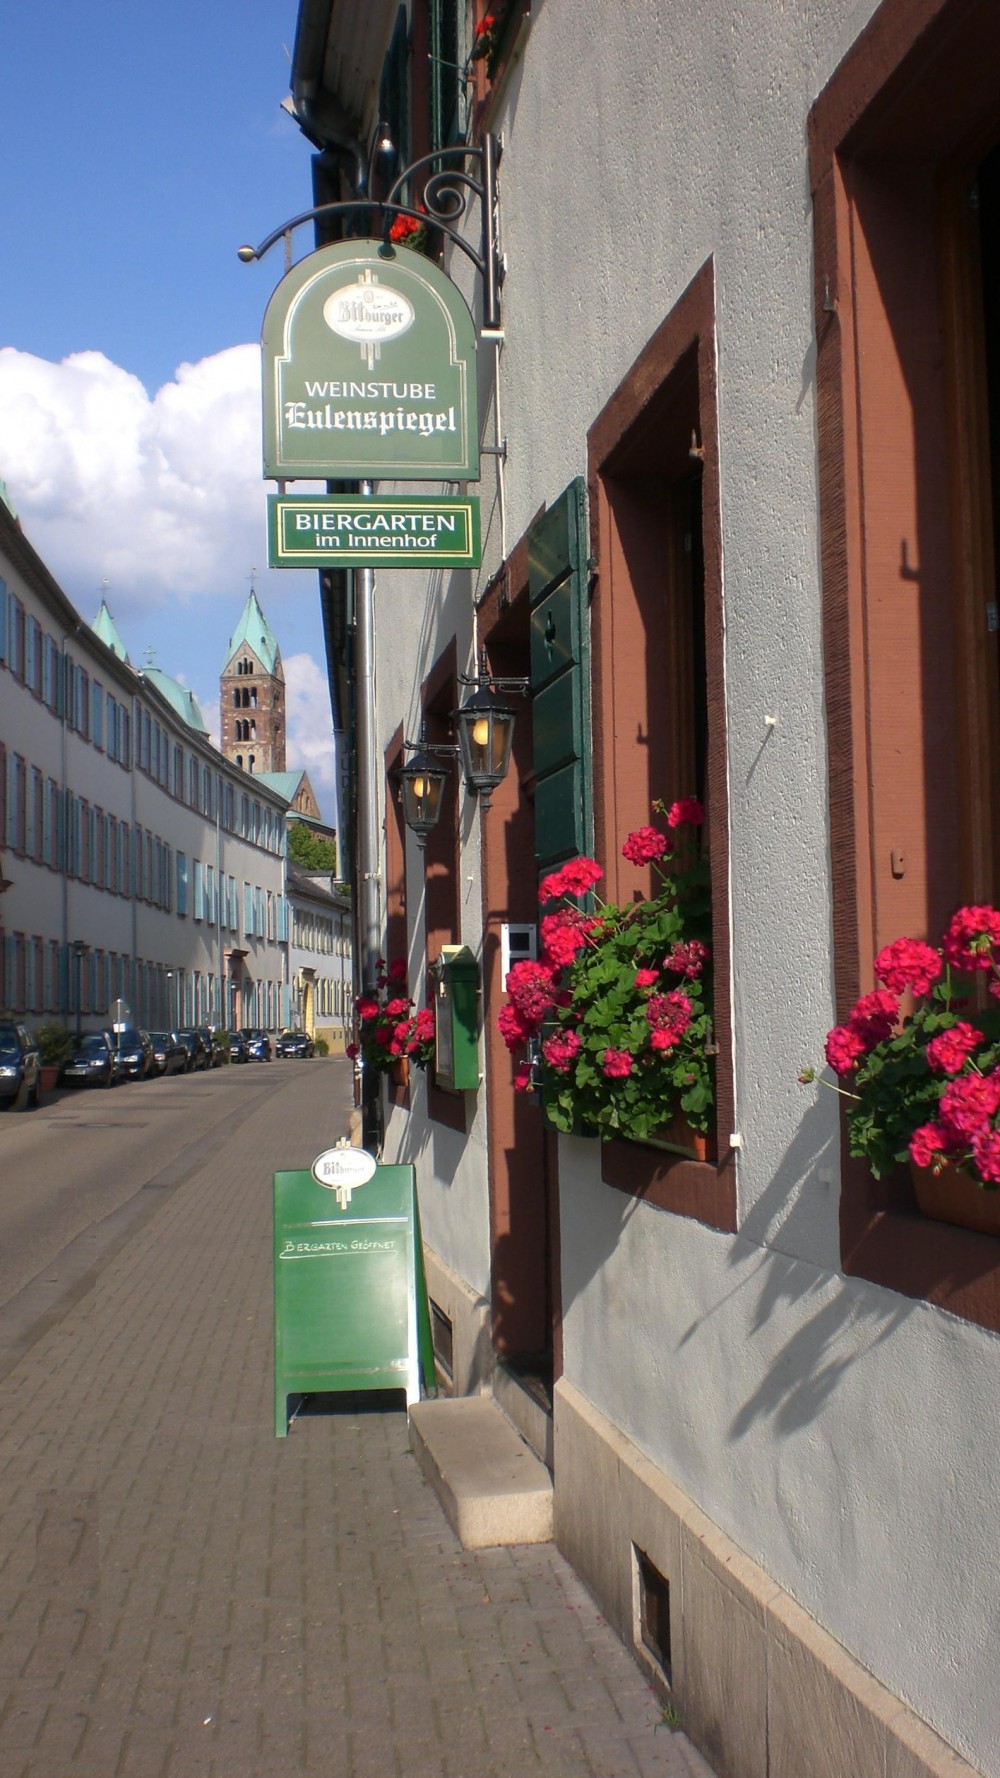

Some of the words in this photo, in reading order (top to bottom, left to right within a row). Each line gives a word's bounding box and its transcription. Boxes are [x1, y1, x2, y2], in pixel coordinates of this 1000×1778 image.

[337, 300, 404, 326] Bitburger
[304, 381, 436, 399] WEINSTUBE
[284, 401, 457, 437] Eulenspiegel
[295, 513, 456, 532] BIERGARTEN
[315, 533, 340, 547] im
[348, 533, 438, 548] Innenhof
[322, 1161, 366, 1176] Bitbur
[284, 1241, 349, 1252] BERGARTEN
